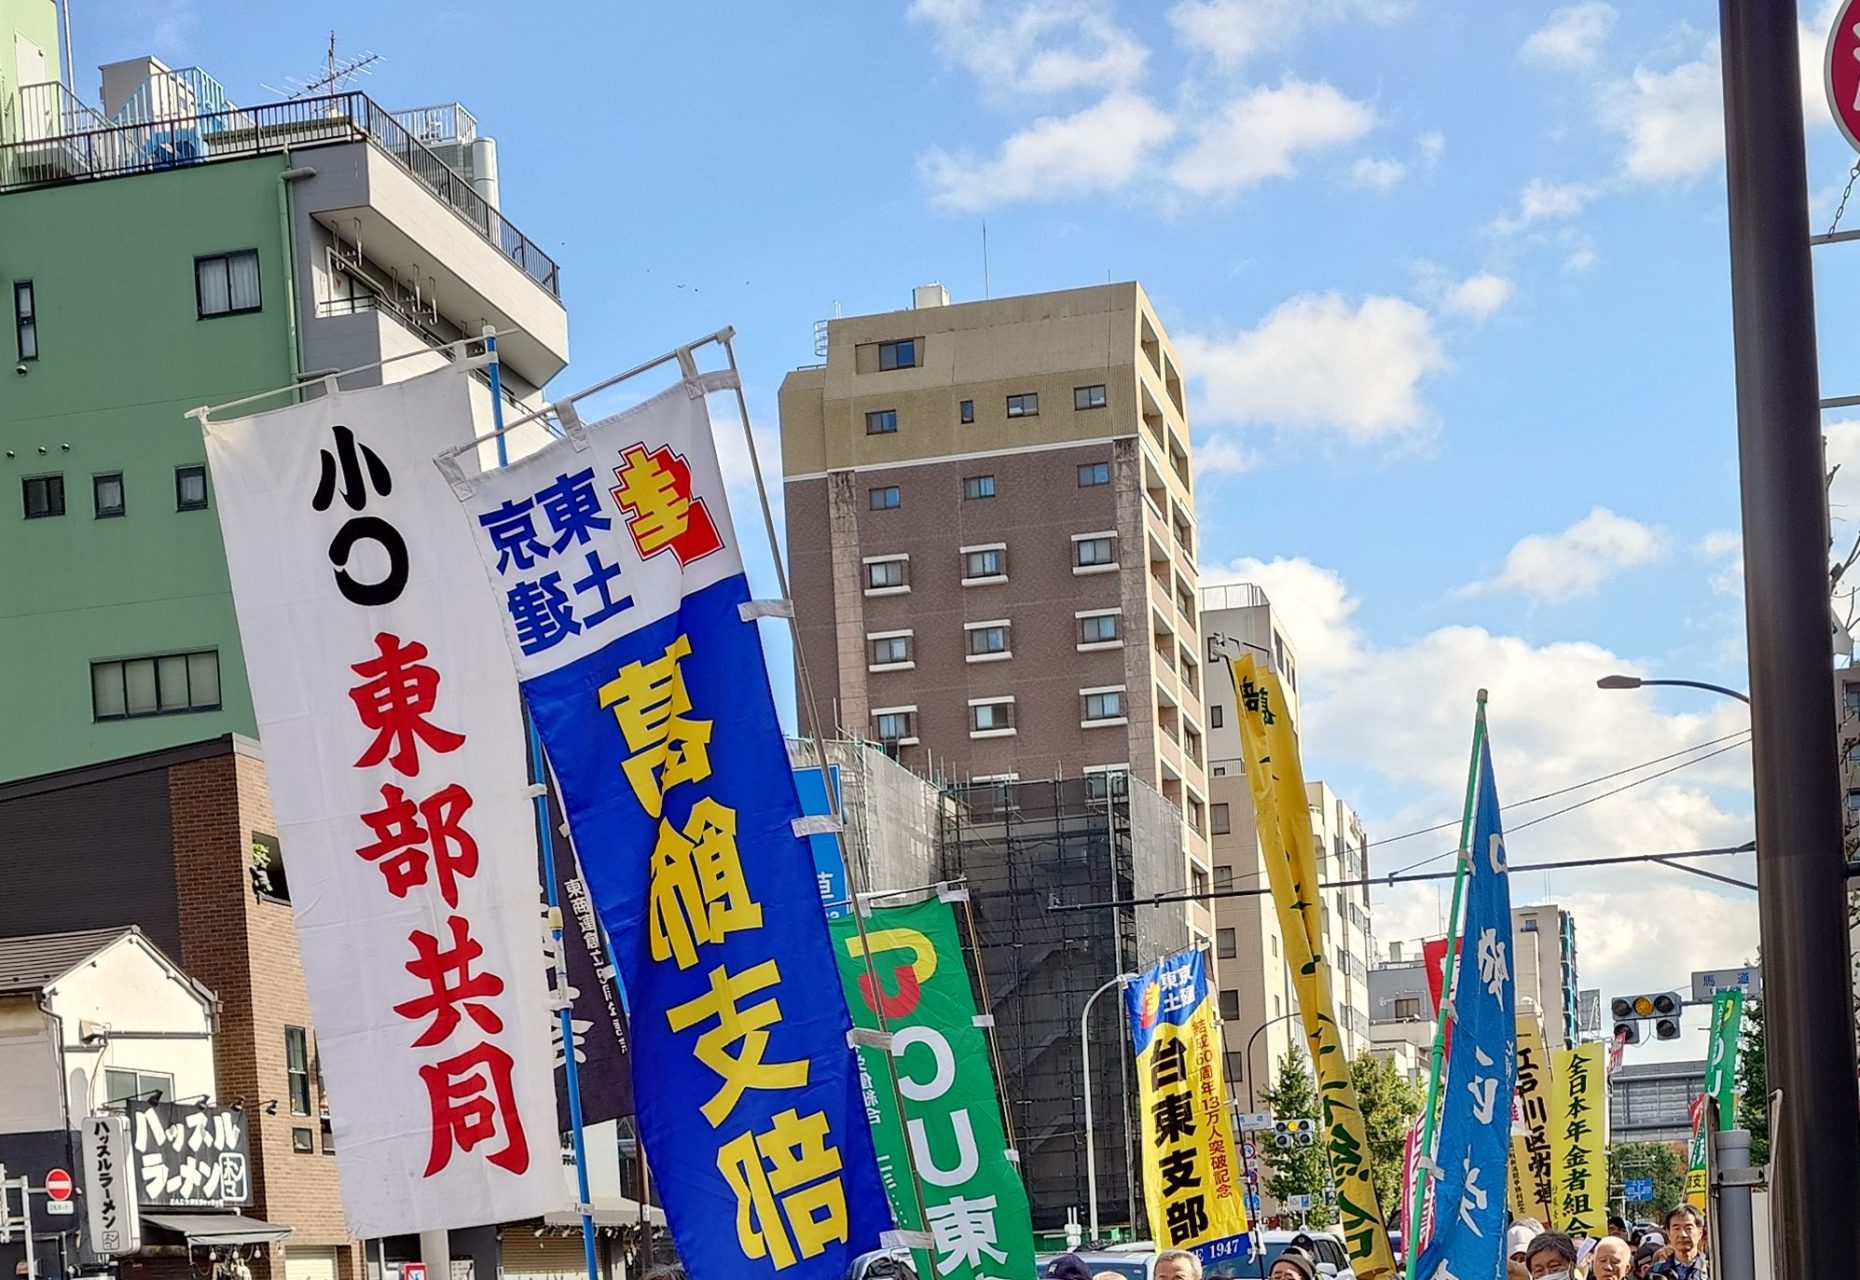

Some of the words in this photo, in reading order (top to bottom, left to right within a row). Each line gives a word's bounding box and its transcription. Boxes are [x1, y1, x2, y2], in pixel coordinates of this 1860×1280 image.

[135, 1107, 241, 1153] ハッスル
[1149, 1037, 1209, 1248] 台東支部
[94, 1121, 117, 1229] ハッスルラーメン
[141, 1153, 221, 1199] ラーメン
[1209, 1238, 1239, 1260] 1947
